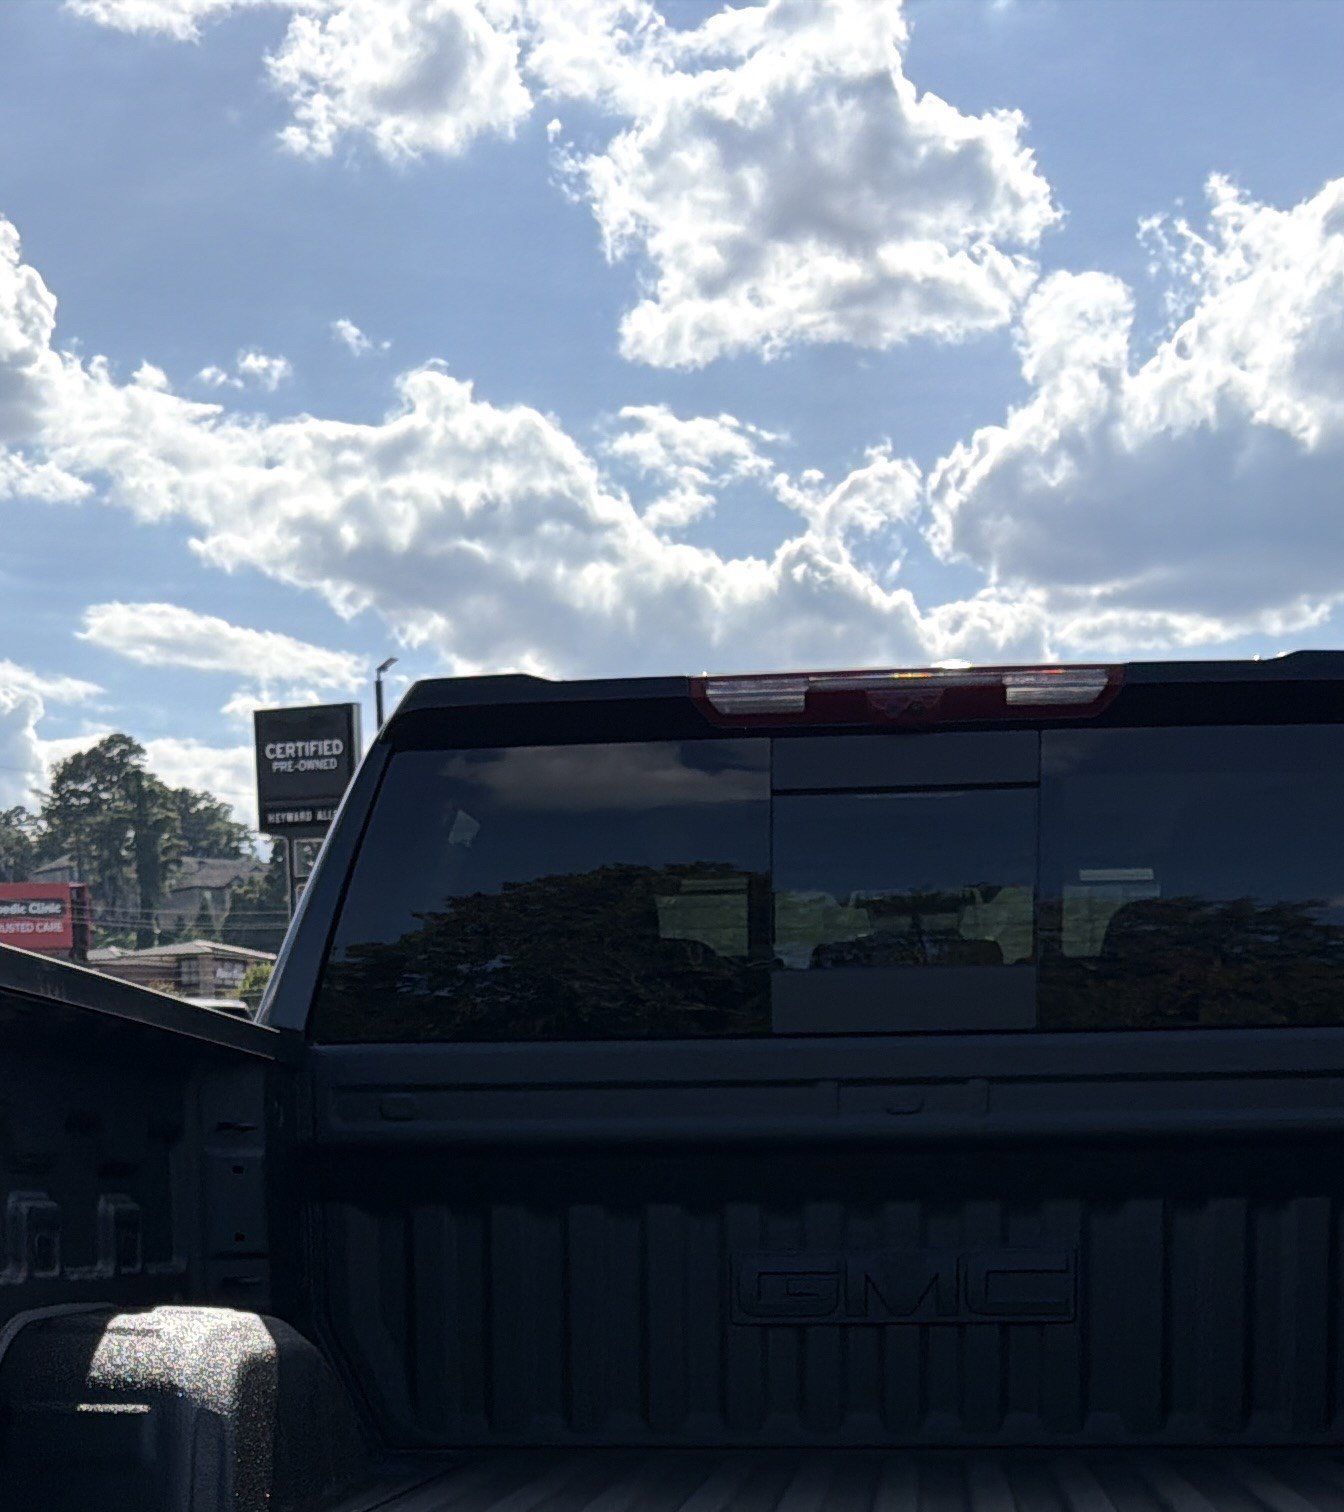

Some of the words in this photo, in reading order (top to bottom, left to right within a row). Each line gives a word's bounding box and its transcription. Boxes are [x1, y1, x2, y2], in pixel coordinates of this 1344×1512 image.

[265, 739, 343, 759] CERTIFIED
[272, 758, 337, 772] PRE-OWNED
[267, 810, 312, 823] HEYWARD
[28, 901, 61, 914] Clinic
[36, 922, 63, 933] CARE
[735, 1251, 1071, 1318] GMC
